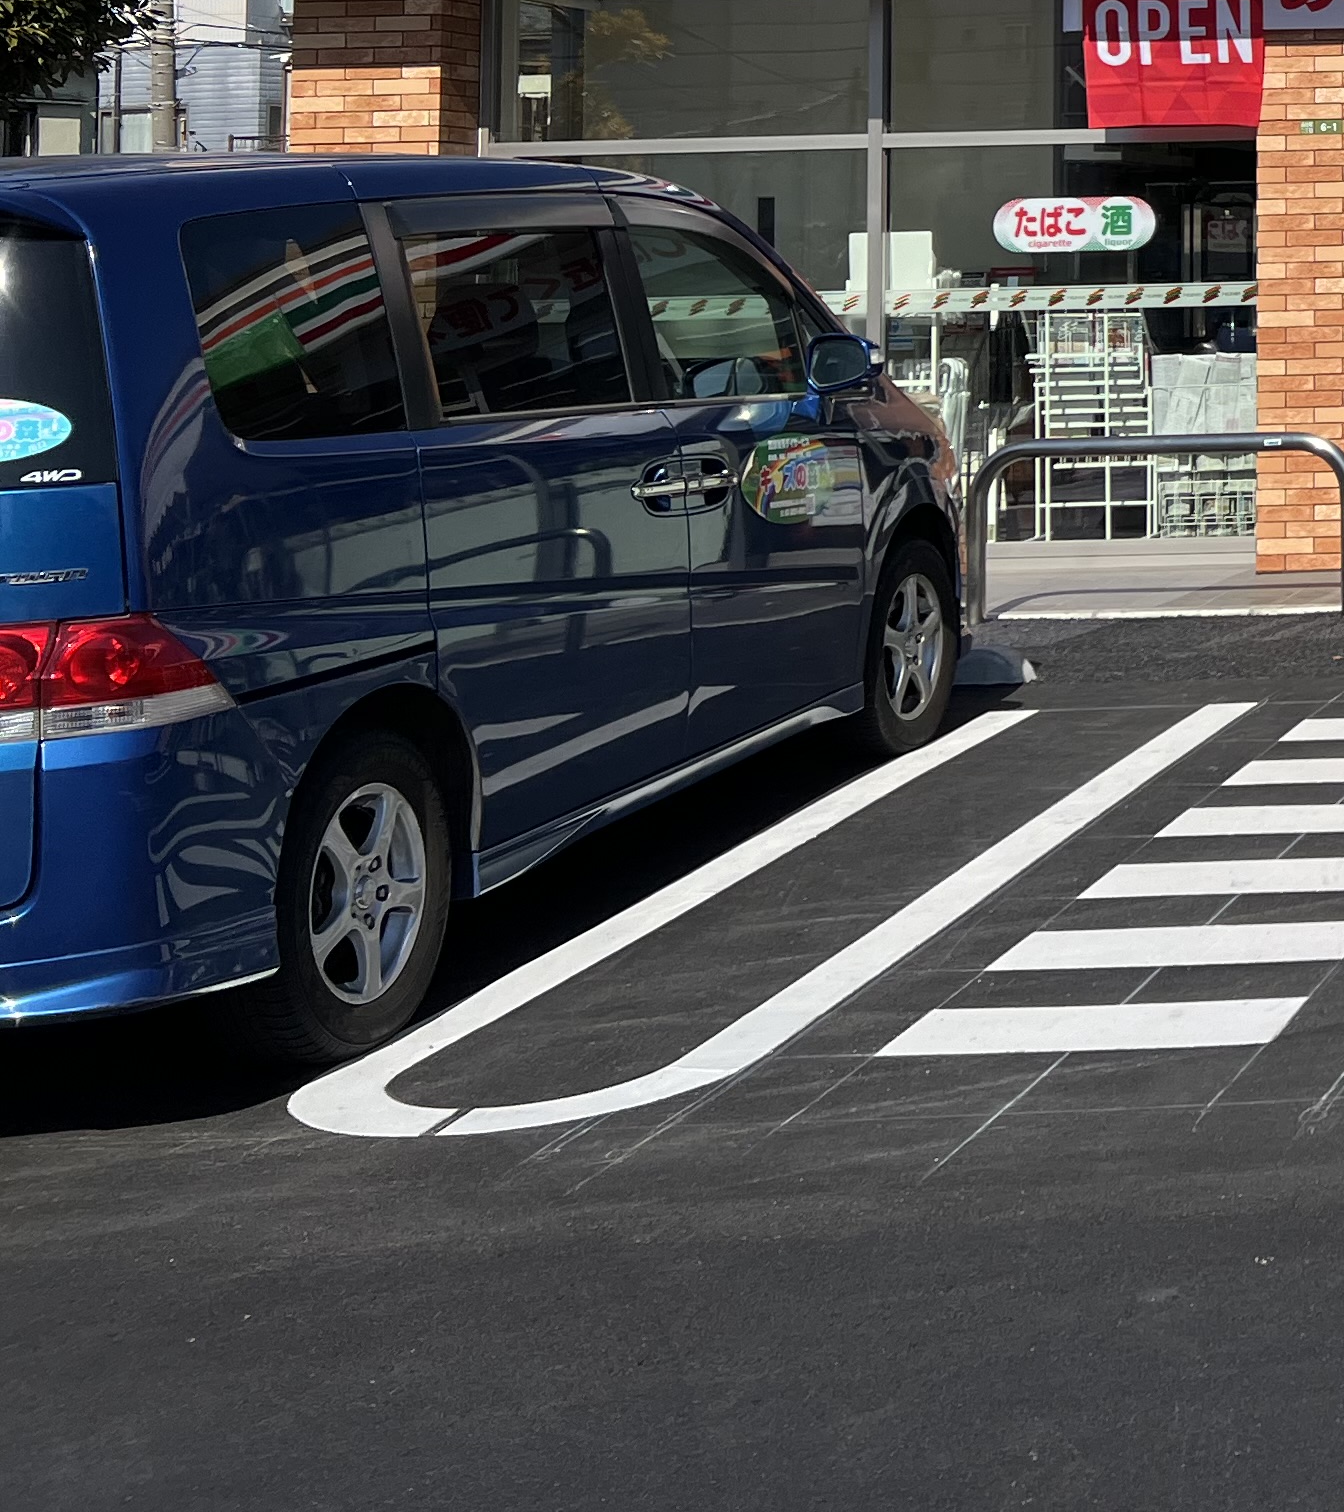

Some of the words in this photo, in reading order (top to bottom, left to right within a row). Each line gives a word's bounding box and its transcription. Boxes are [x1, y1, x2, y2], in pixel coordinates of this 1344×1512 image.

[1320, 122, 1337, 132] 6-1
[1015, 205, 1086, 238] たばこ
[1102, 205, 1133, 236] 酒
[1028, 239, 1072, 249] cigarette
[1105, 238, 1133, 246] liquor
[20, 469, 82, 483] 4WD
